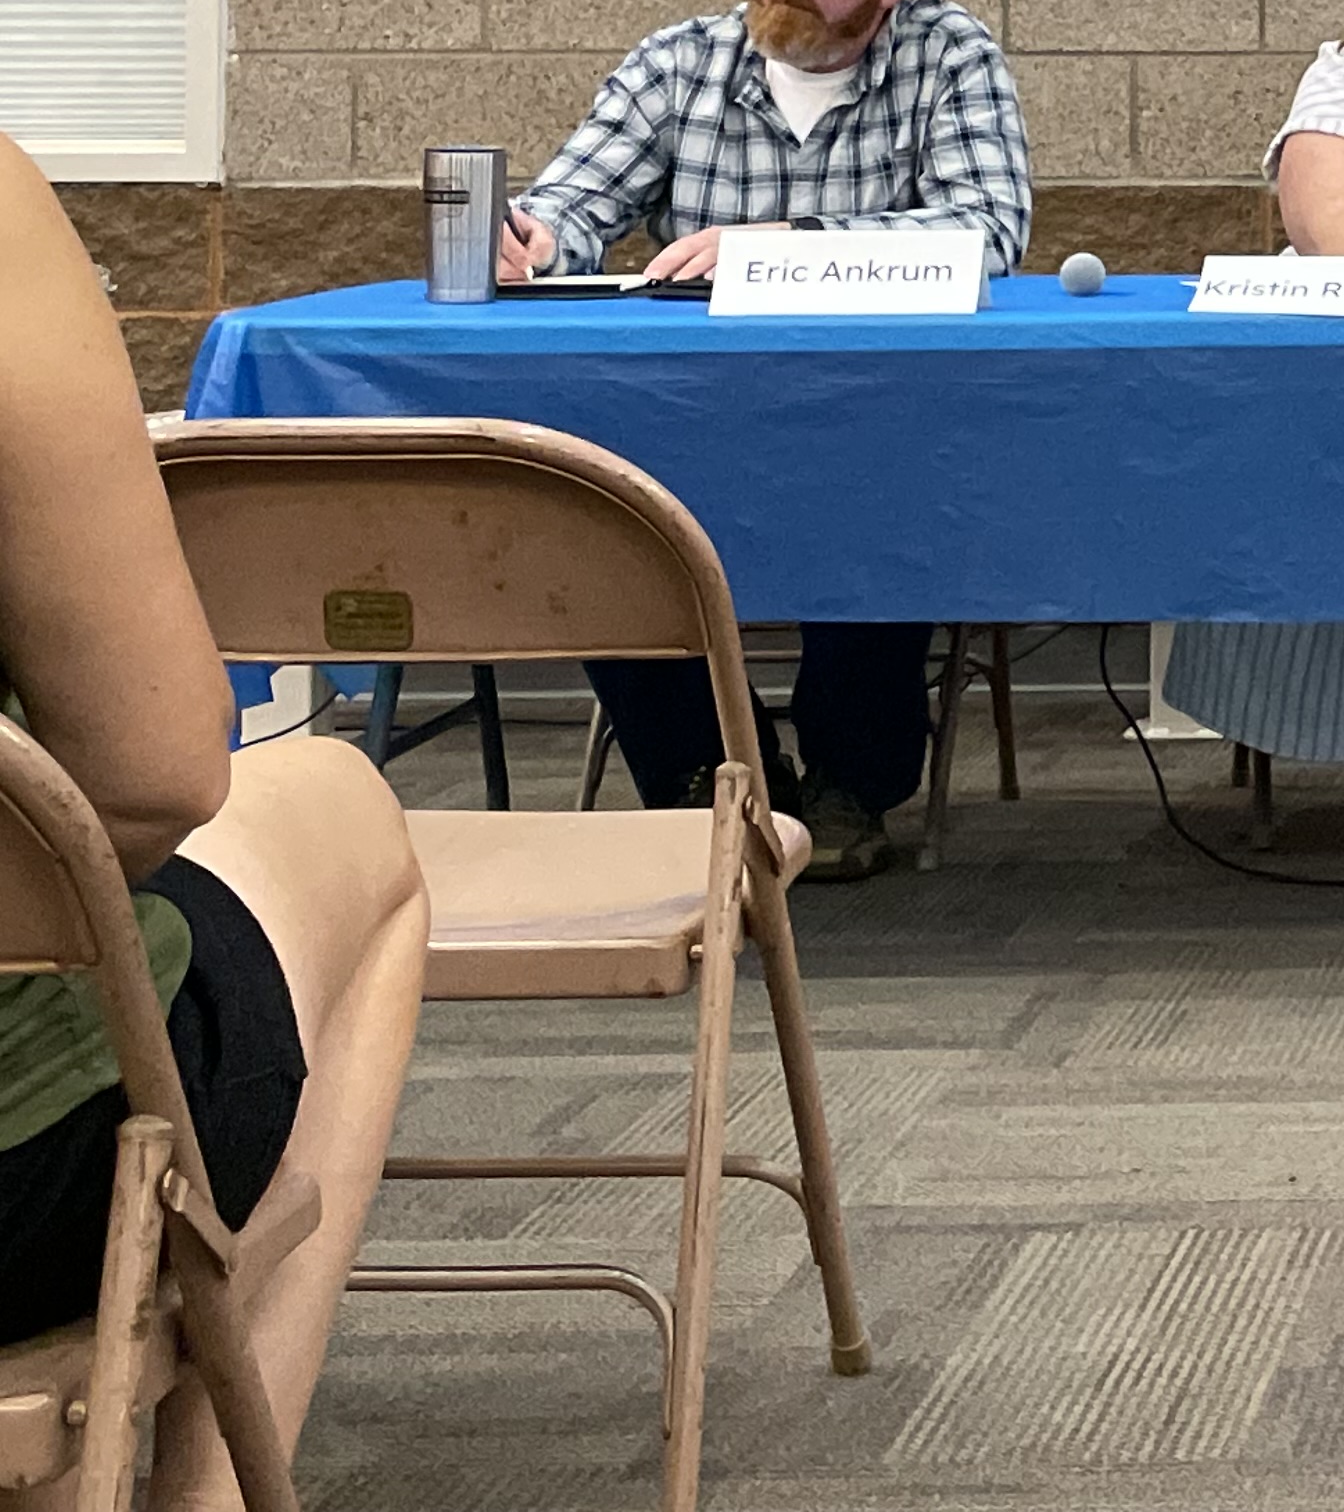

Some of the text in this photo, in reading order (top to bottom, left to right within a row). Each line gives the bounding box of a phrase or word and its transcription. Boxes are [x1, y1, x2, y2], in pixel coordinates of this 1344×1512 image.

[745, 257, 954, 284] Eric Ankrum
[1203, 279, 1308, 298] Kristin
